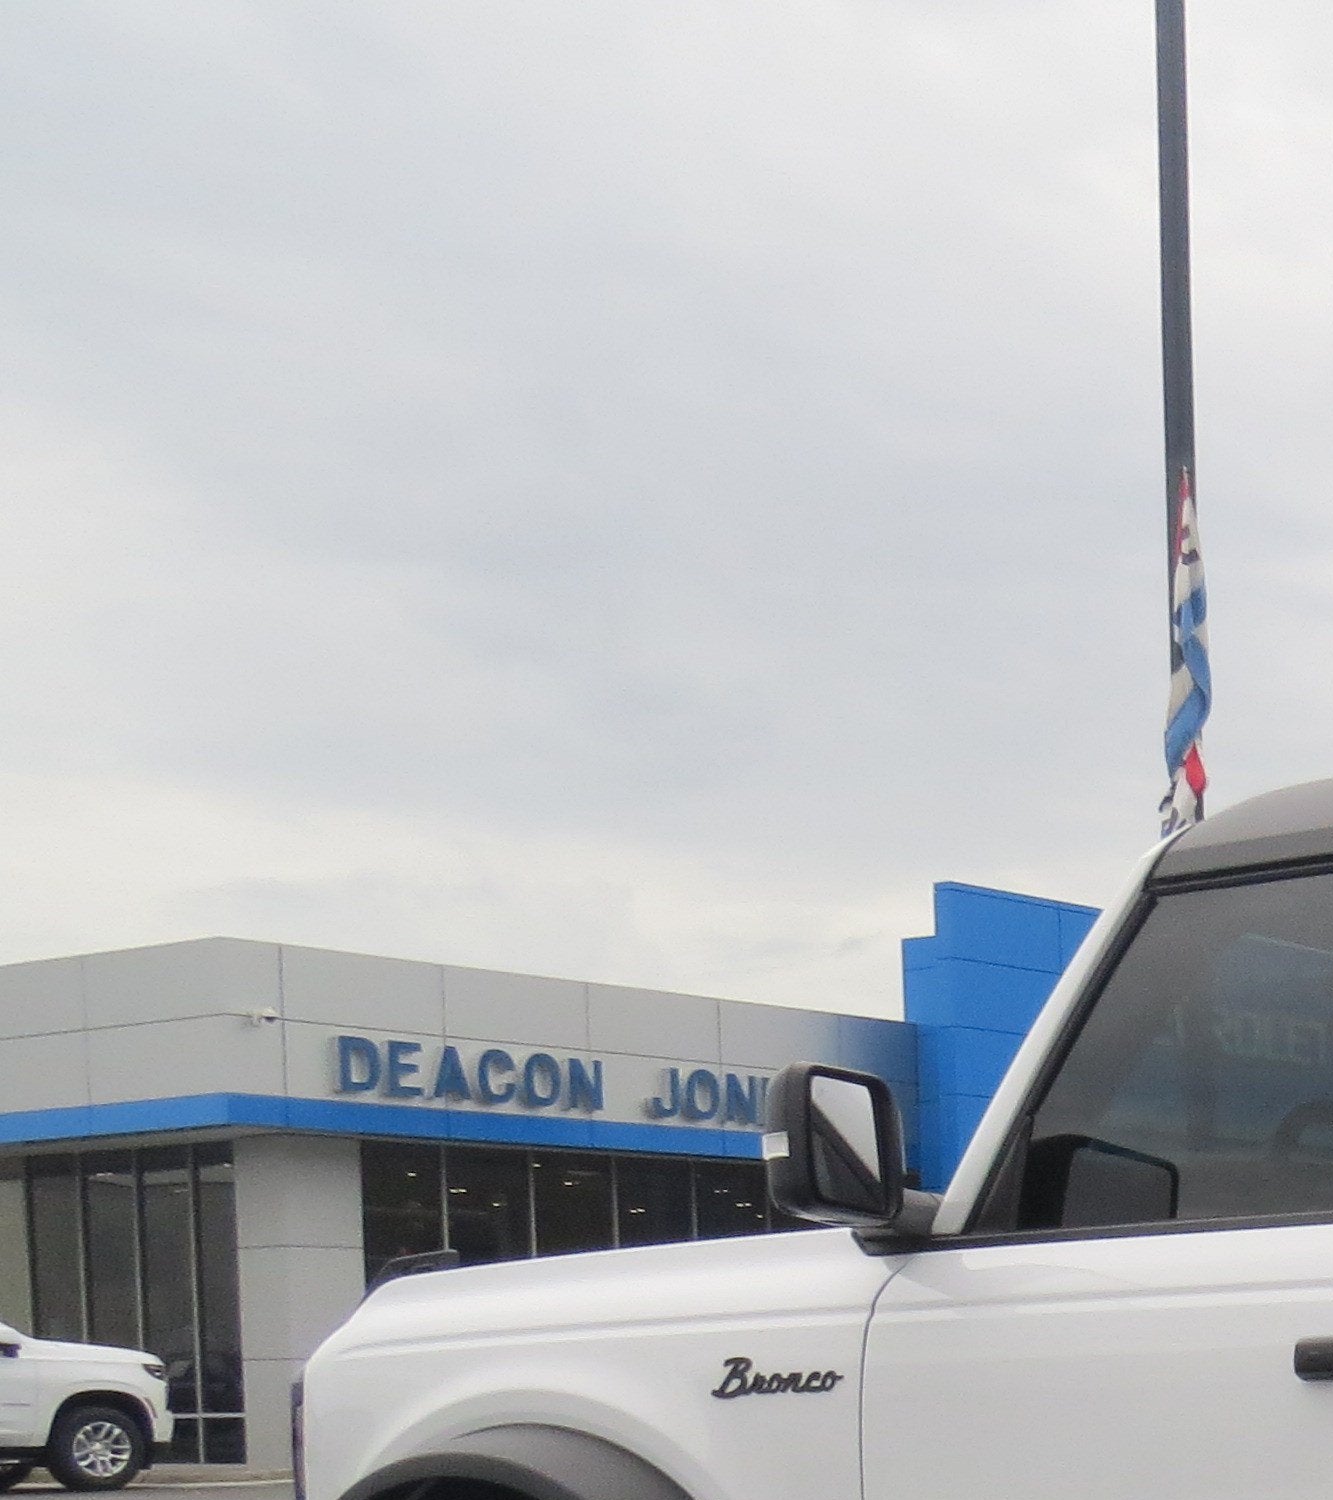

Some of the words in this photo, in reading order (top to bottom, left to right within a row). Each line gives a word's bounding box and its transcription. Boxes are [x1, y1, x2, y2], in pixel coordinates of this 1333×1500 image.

[337, 1035, 604, 1111] DEACON
[652, 1066, 770, 1125] JON
[711, 1356, 844, 1399] Bronco
